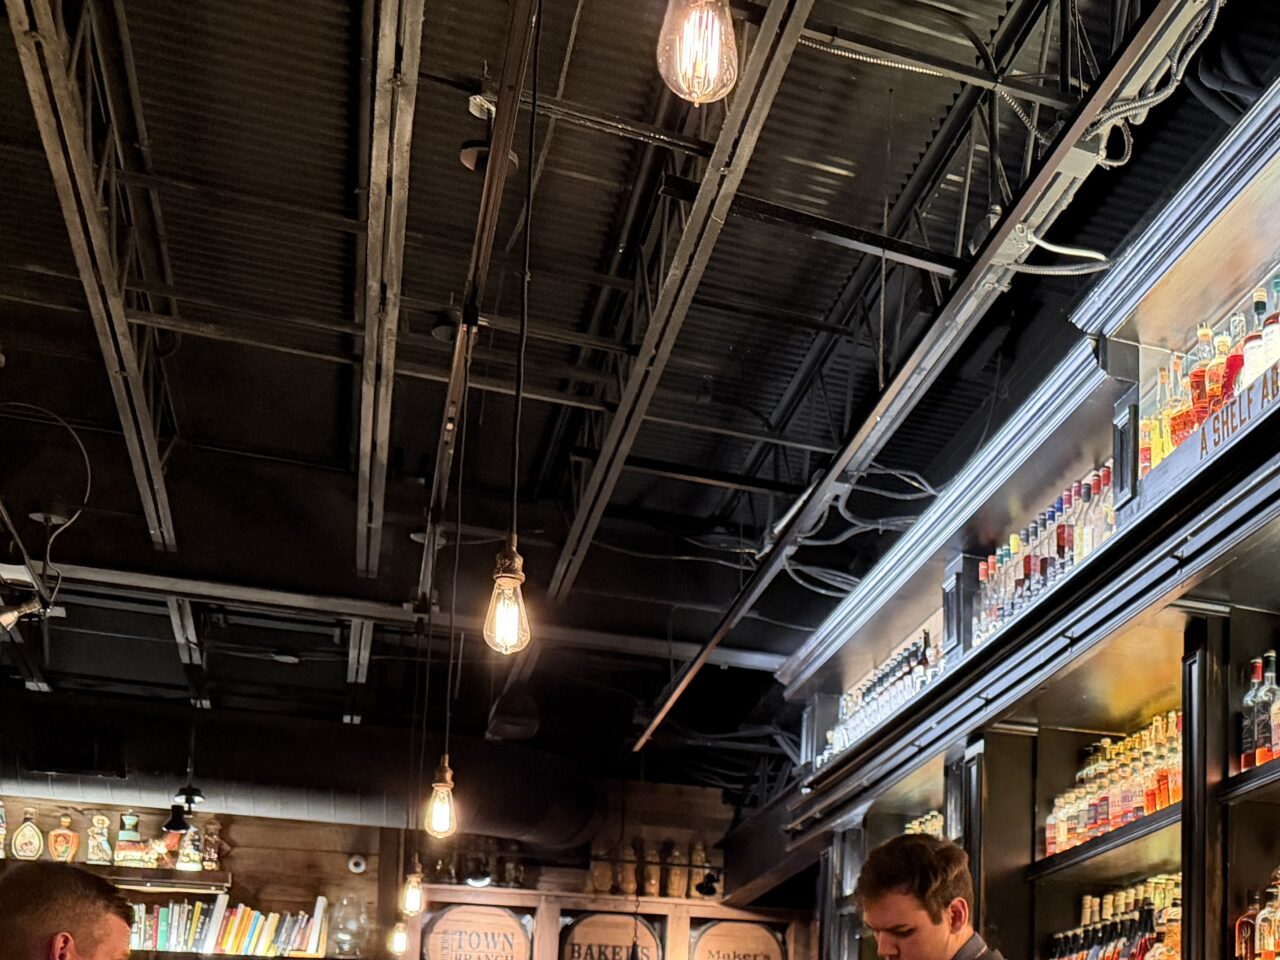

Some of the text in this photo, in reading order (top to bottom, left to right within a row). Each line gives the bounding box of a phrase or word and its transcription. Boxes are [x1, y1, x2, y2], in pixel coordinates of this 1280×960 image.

[1200, 425, 1209, 460] A
[1212, 384, 1255, 448] SHELF
[454, 930, 515, 952] TOWN
